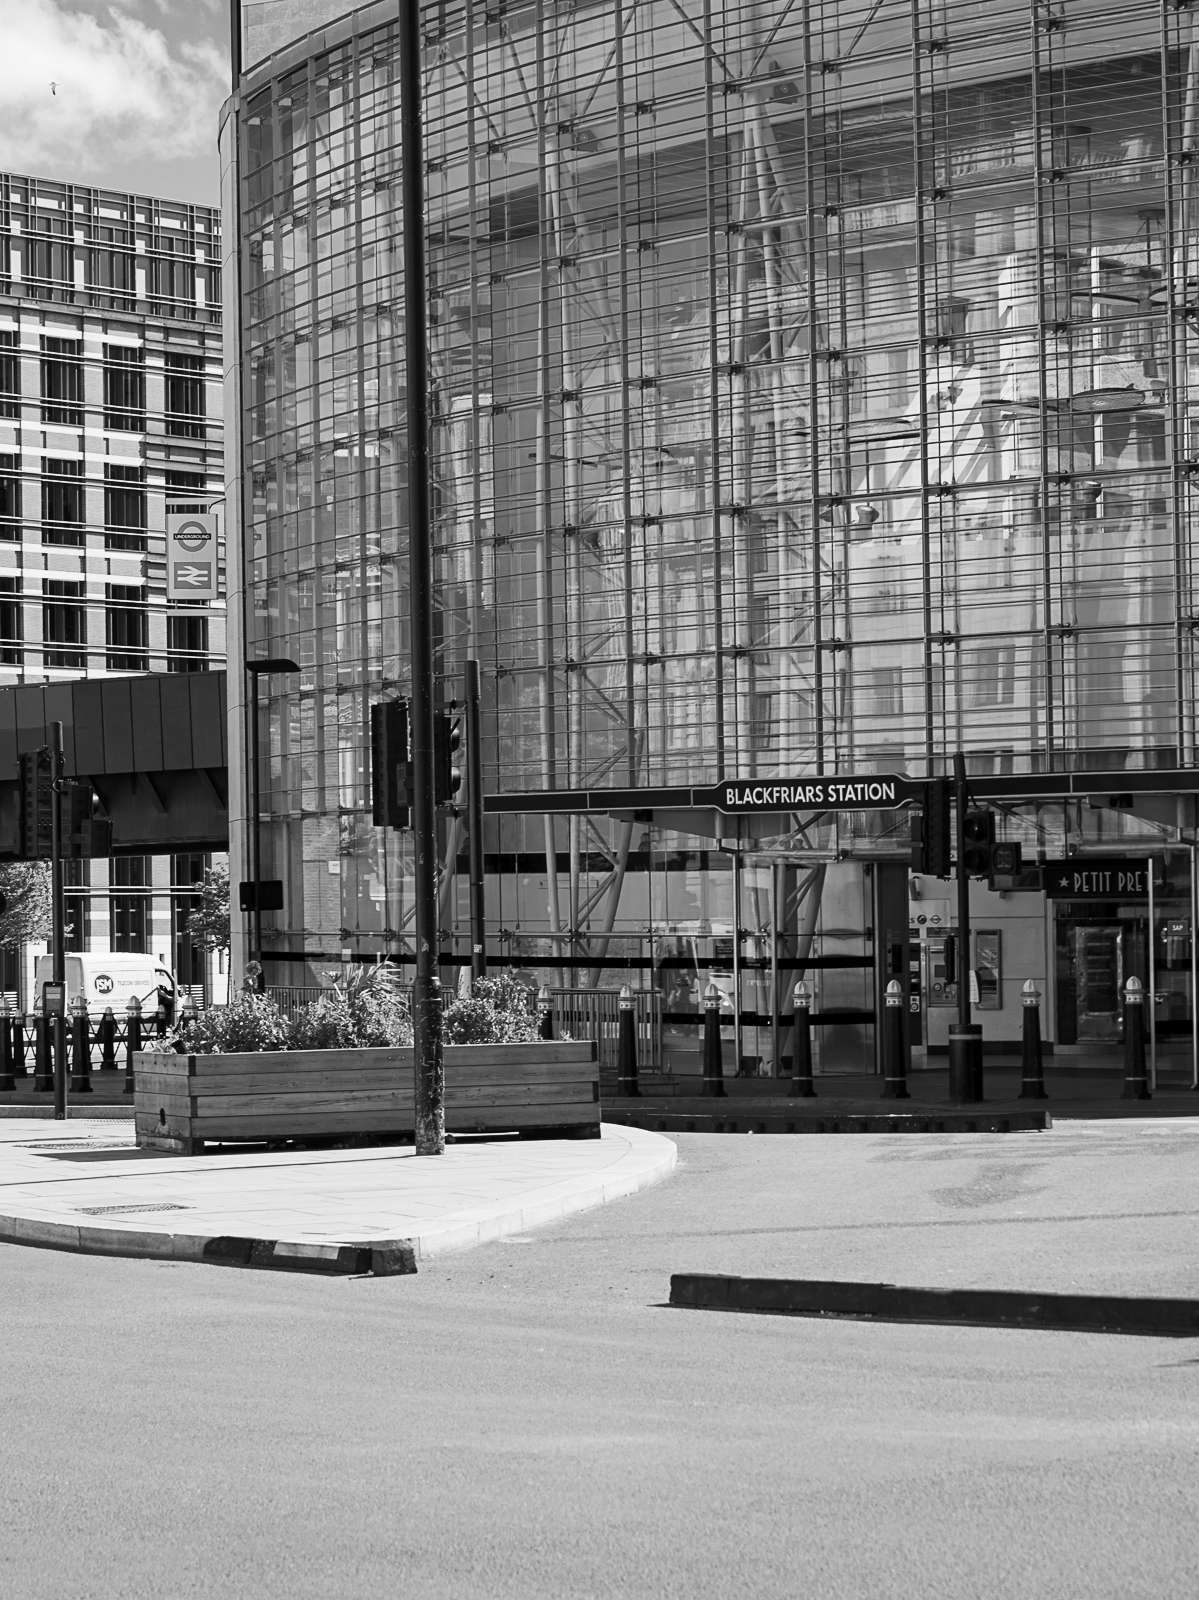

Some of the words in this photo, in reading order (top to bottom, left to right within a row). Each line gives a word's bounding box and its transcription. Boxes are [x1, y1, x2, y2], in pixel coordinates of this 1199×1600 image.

[726, 785, 824, 805] BLACKFRIARS
[828, 782, 895, 802] STATION
[1073, 871, 1112, 893] PETIT
